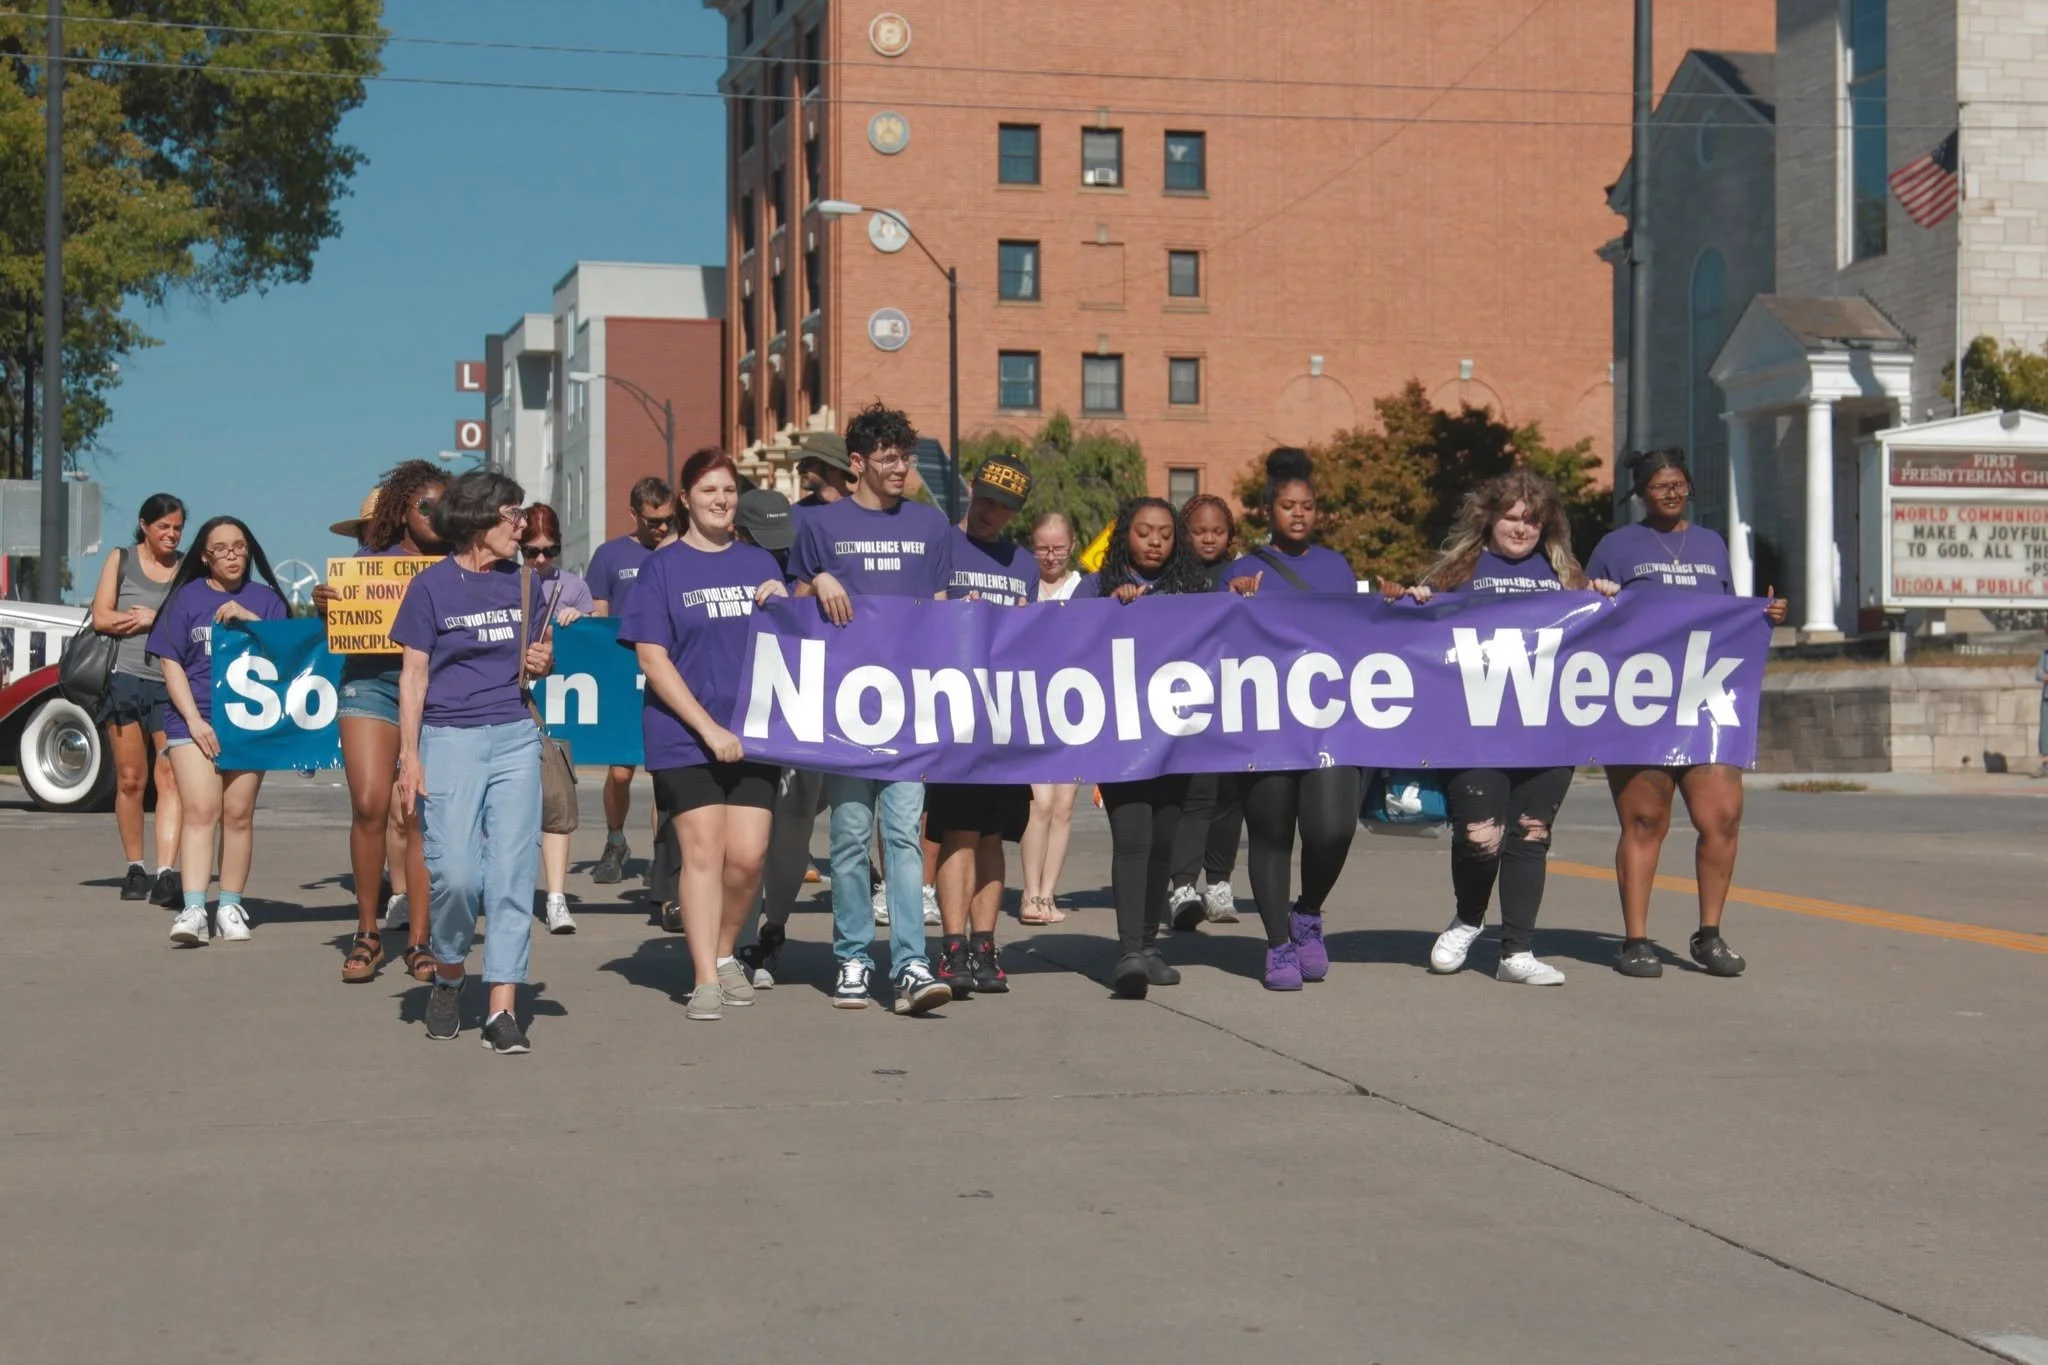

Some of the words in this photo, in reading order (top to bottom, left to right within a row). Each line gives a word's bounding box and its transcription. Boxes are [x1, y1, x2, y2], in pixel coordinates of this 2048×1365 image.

[1974, 454, 2016, 467] FIRST
[1900, 467, 2016, 483] PRESBYTERIAN
[1913, 525, 1957, 540] MAKE
[1968, 526, 1978, 541] A
[835, 541, 899, 555] NONVIOLENCE
[901, 541, 925, 555] WEEK
[1908, 542, 1927, 557] TO
[1984, 544, 2012, 559] ALL
[329, 562, 345, 577] AT
[357, 561, 383, 576] THE
[864, 558, 875, 570] IN
[877, 558, 901, 571] OHIO
[1695, 563, 1717, 576] WEEK
[1662, 573, 1672, 585] IN
[1675, 575, 1697, 586] OHIO
[1976, 579, 2034, 594] PUBLIC
[343, 585, 360, 600] OF
[683, 586, 745, 608] NONVIOLENCE
[329, 610, 383, 625] STANDS
[706, 602, 718, 619] IN
[718, 601, 742, 617] OHIO
[444, 610, 509, 629] NONVIOLENCE
[478, 629, 488, 642] IN
[488, 627, 514, 642] OHIO
[743, 632, 1414, 746] Nonviolence
[1452, 628, 1745, 727] Week
